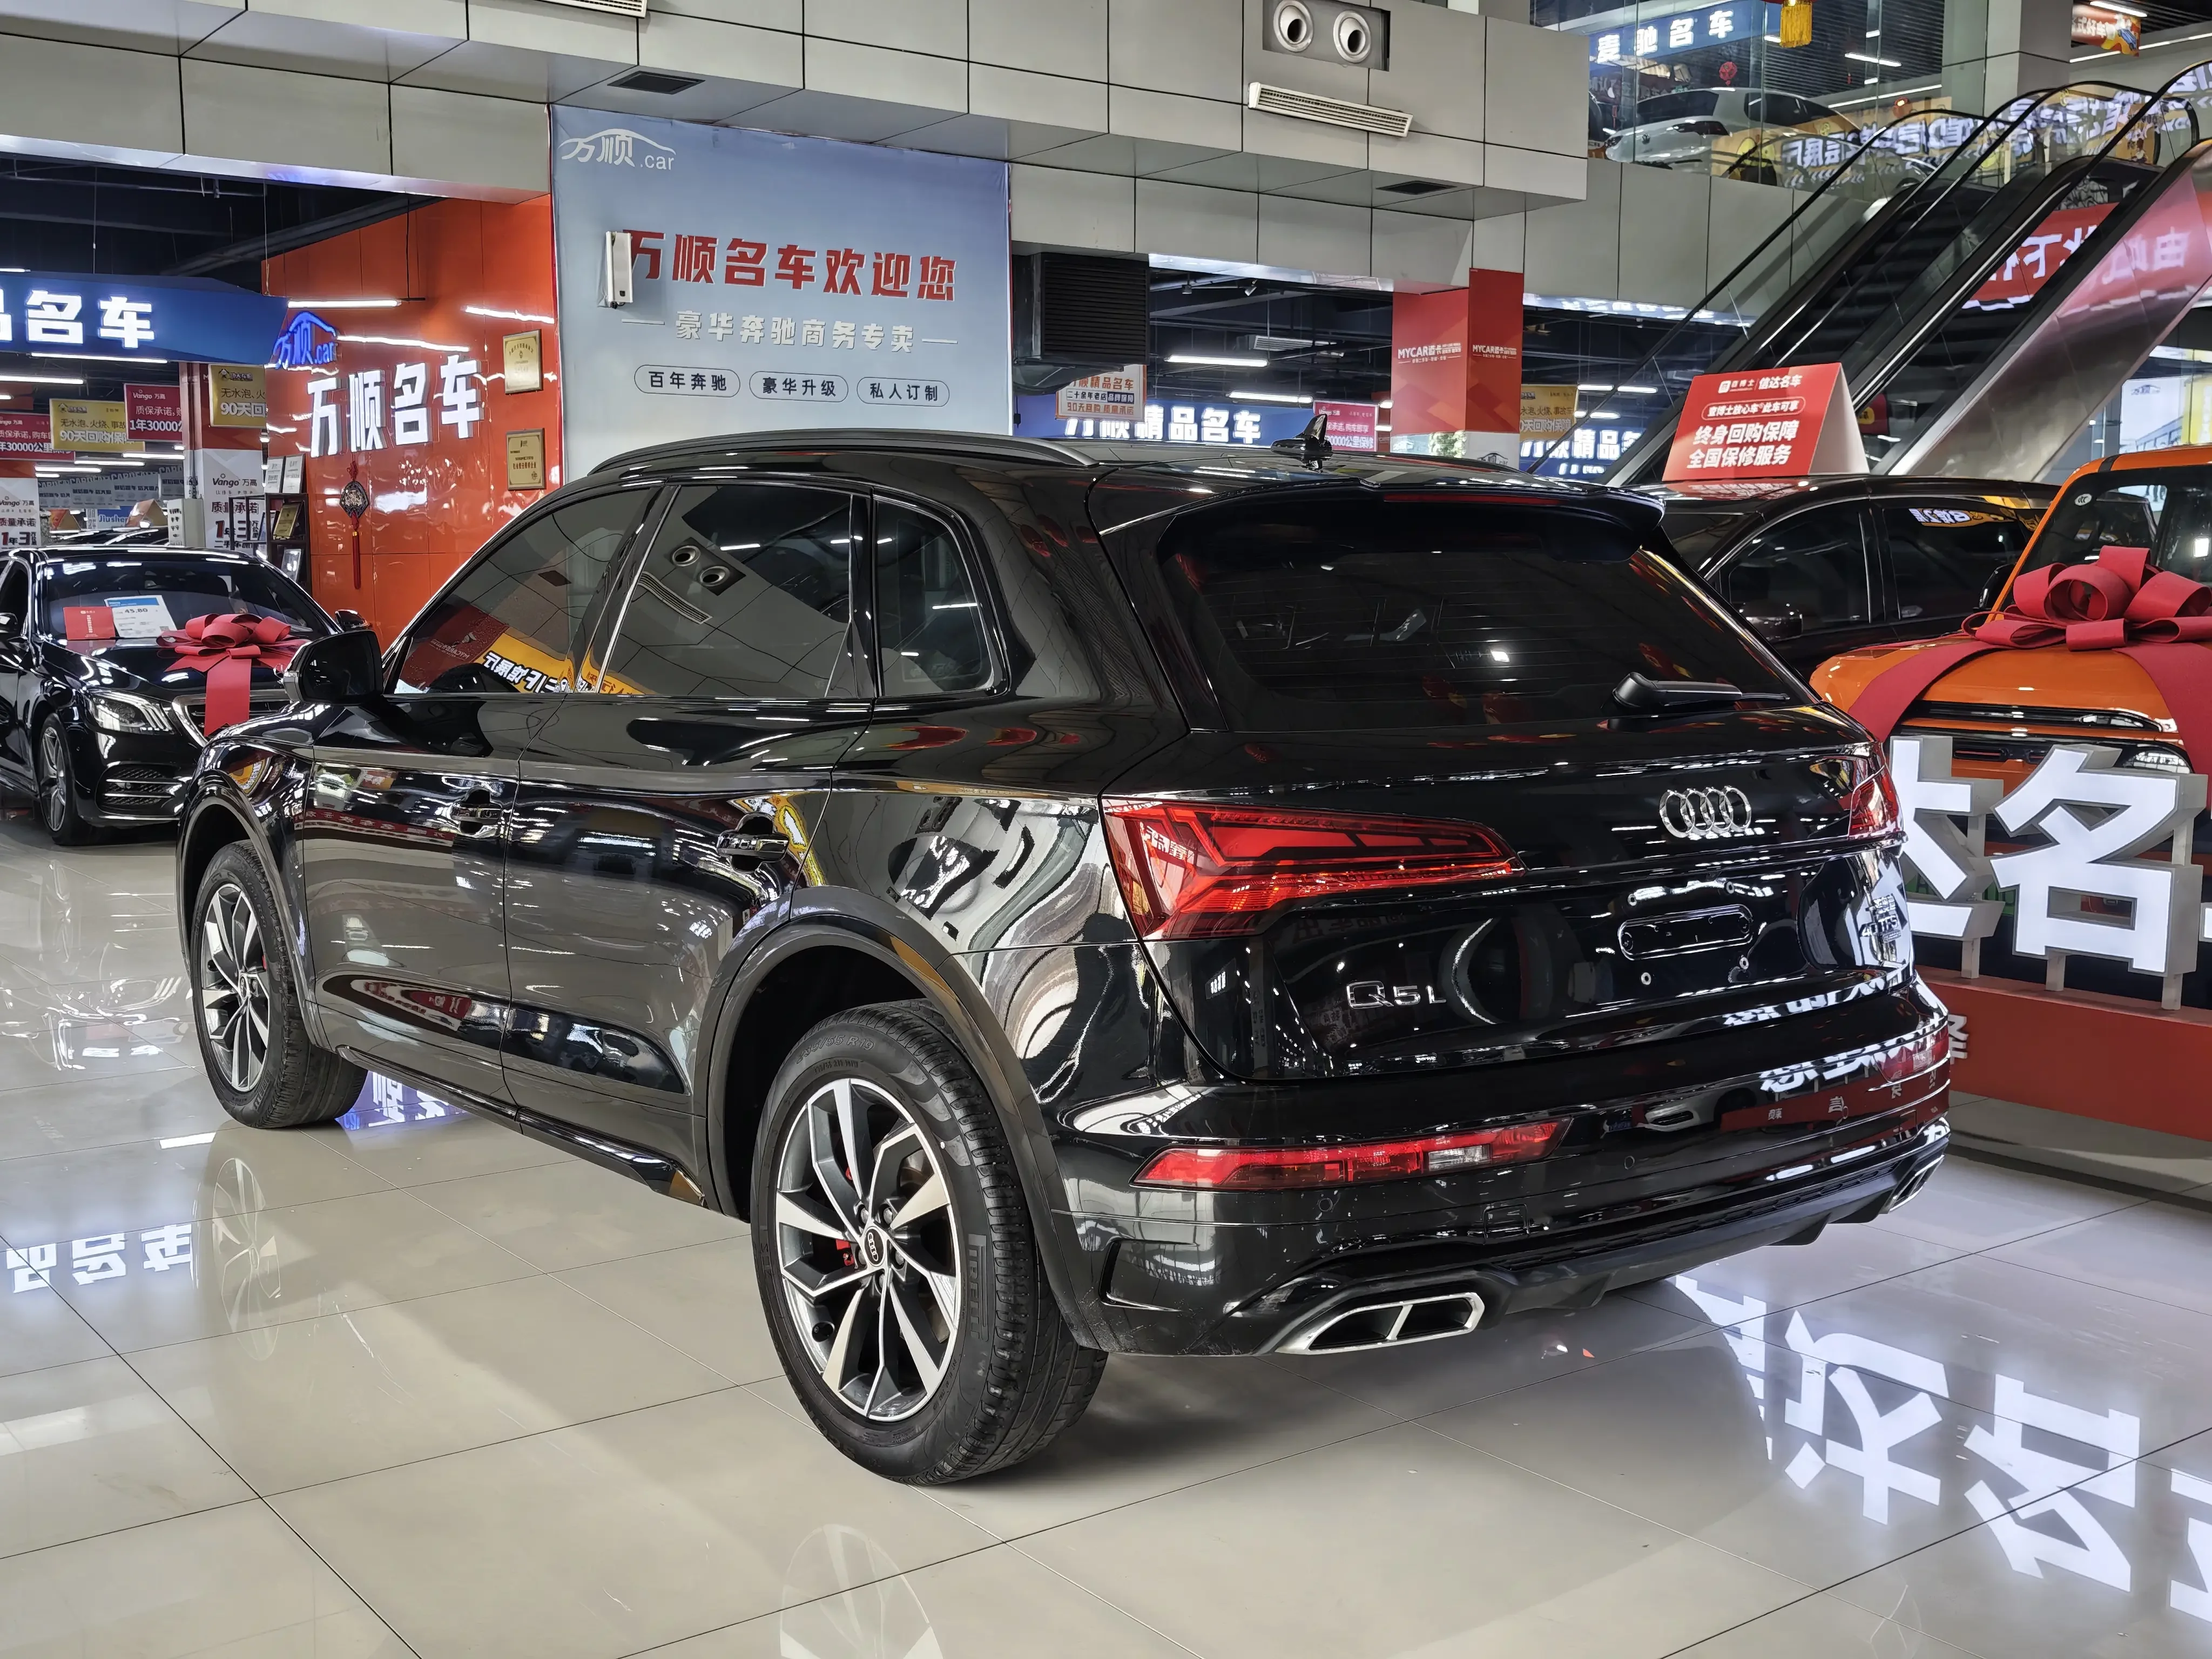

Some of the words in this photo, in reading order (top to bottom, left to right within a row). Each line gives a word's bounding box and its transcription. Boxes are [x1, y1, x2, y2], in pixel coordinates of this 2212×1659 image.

[623, 229, 957, 302] 万顺名车欢迎您
[676, 310, 915, 353] 豪华奔驰商务专卖
[649, 371, 728, 393] 百年奔驰
[761, 377, 836, 398] 豪华升级
[869, 382, 939, 402] 私人订制
[1758, 374, 1803, 390] 信达名车
[133, 392, 152, 401] Vango
[307, 354, 482, 458] 万顺名车
[1692, 420, 1800, 445] 终身回购保障
[1687, 444, 1792, 469] 全国保修服务
[212, 477, 240, 488] Vango
[242, 478, 257, 487] 万高
[1346, 981, 1447, 1009] Q5L
